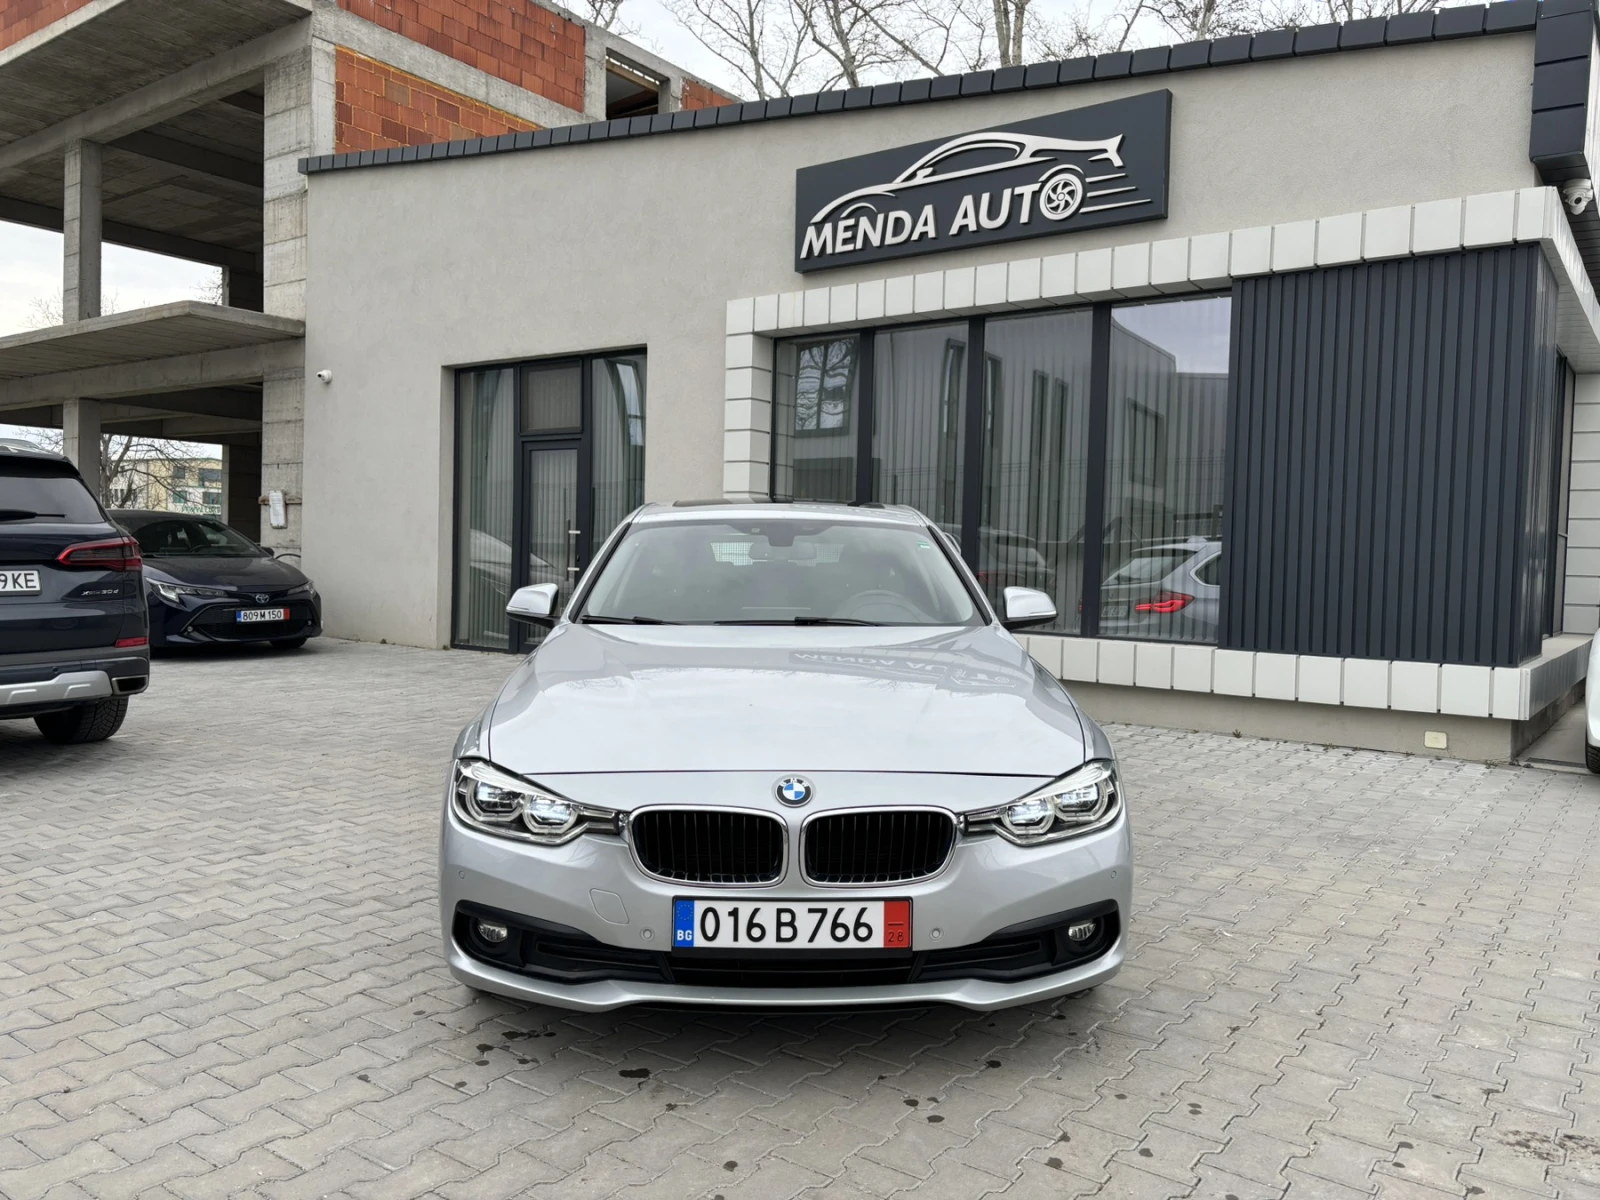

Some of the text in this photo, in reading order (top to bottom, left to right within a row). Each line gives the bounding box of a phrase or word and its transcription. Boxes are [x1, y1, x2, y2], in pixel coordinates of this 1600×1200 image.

[800, 203, 937, 260] MENDA
[676, 930, 693, 941] BG
[887, 930, 904, 942] 28
